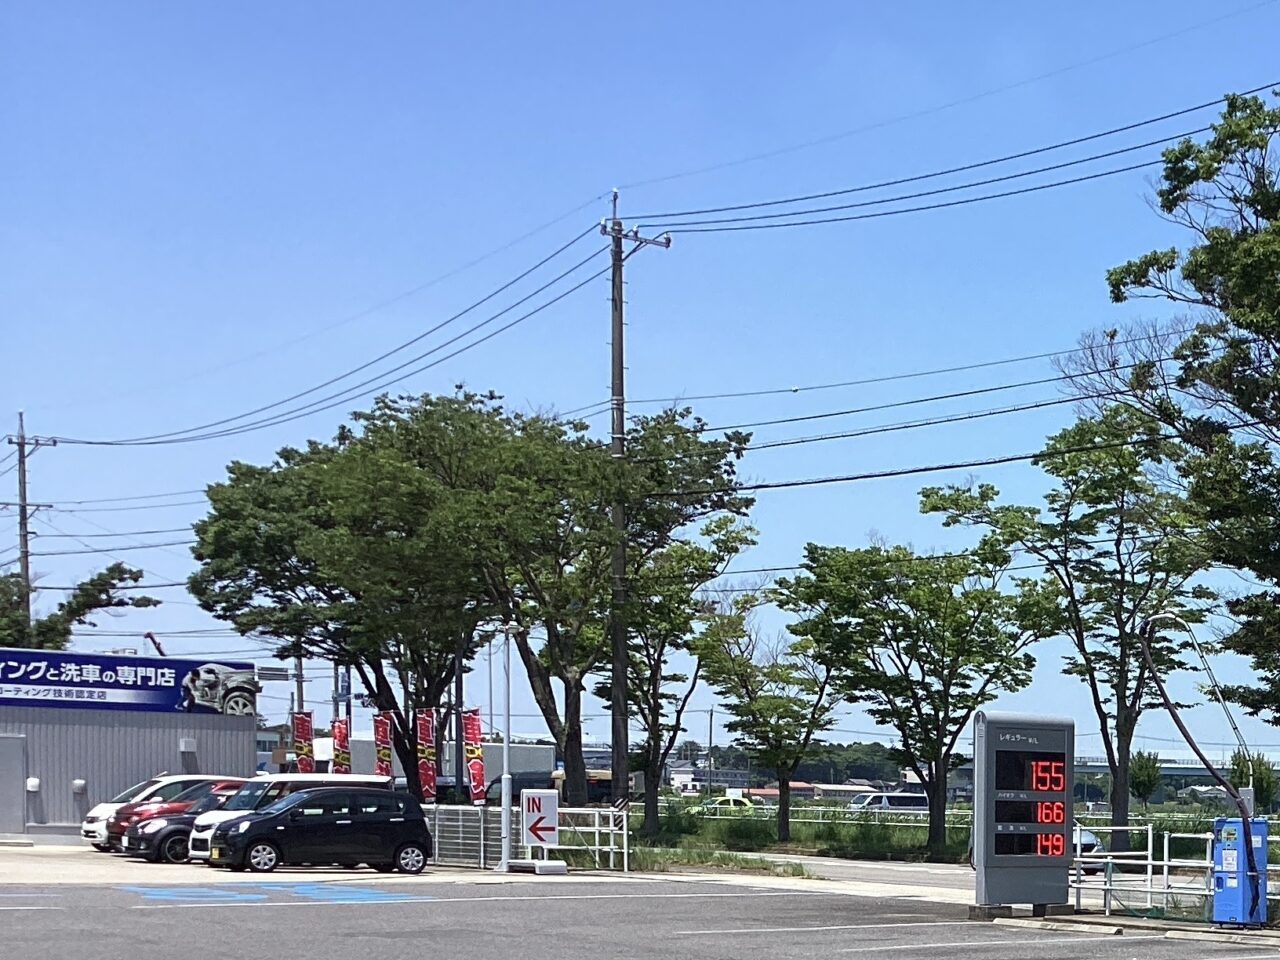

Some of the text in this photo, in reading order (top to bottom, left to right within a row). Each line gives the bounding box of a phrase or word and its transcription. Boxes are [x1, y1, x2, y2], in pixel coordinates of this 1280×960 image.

[1031, 761, 1064, 791] 155
[527, 796, 542, 813] IN
[1037, 802, 1064, 823] 166
[1037, 833, 1064, 855] 149
